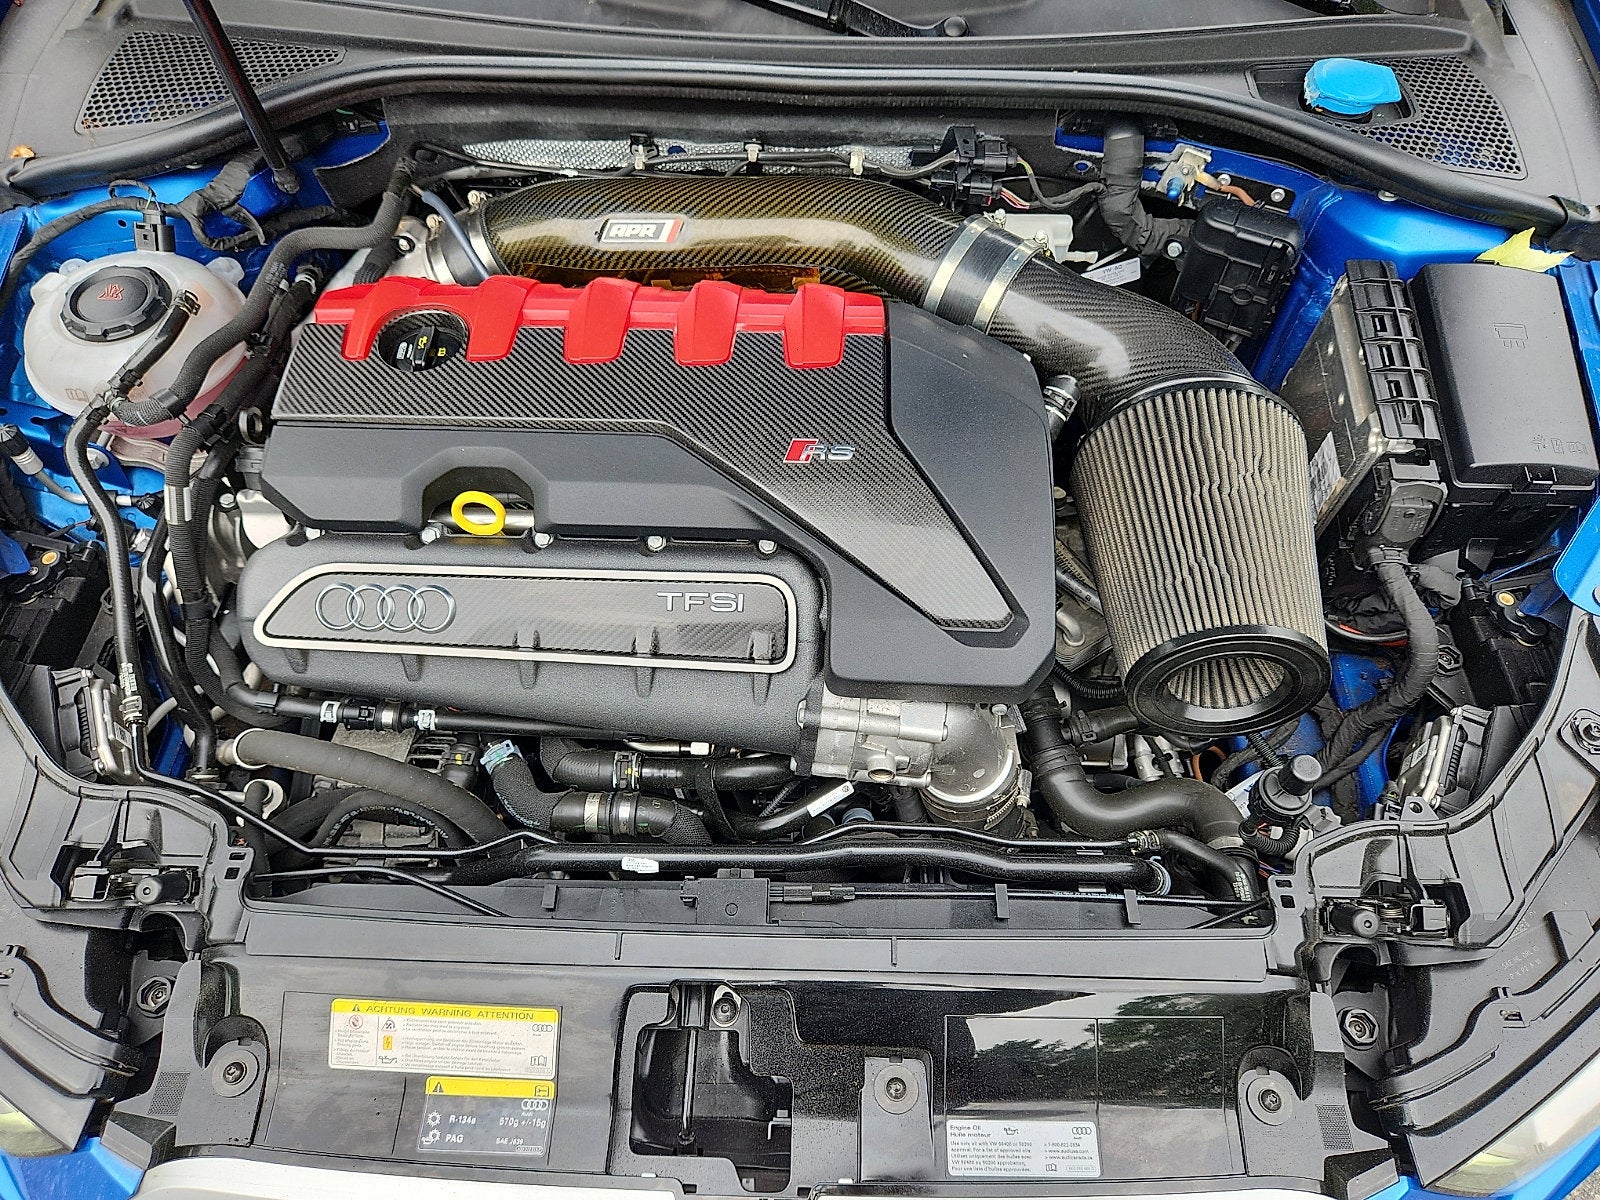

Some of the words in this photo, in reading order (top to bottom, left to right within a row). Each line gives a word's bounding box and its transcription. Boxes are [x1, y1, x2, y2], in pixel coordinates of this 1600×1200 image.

[609, 224, 657, 238] APR
[797, 442, 855, 462] RS
[656, 592, 745, 612] TFSI
[366, 1006, 415, 1014] ACHTUNG
[421, 1008, 471, 1017] WARNING
[477, 1010, 533, 1020] ATTENTION
[448, 1115, 476, 1124] R-134a
[445, 1134, 464, 1143] PAG
